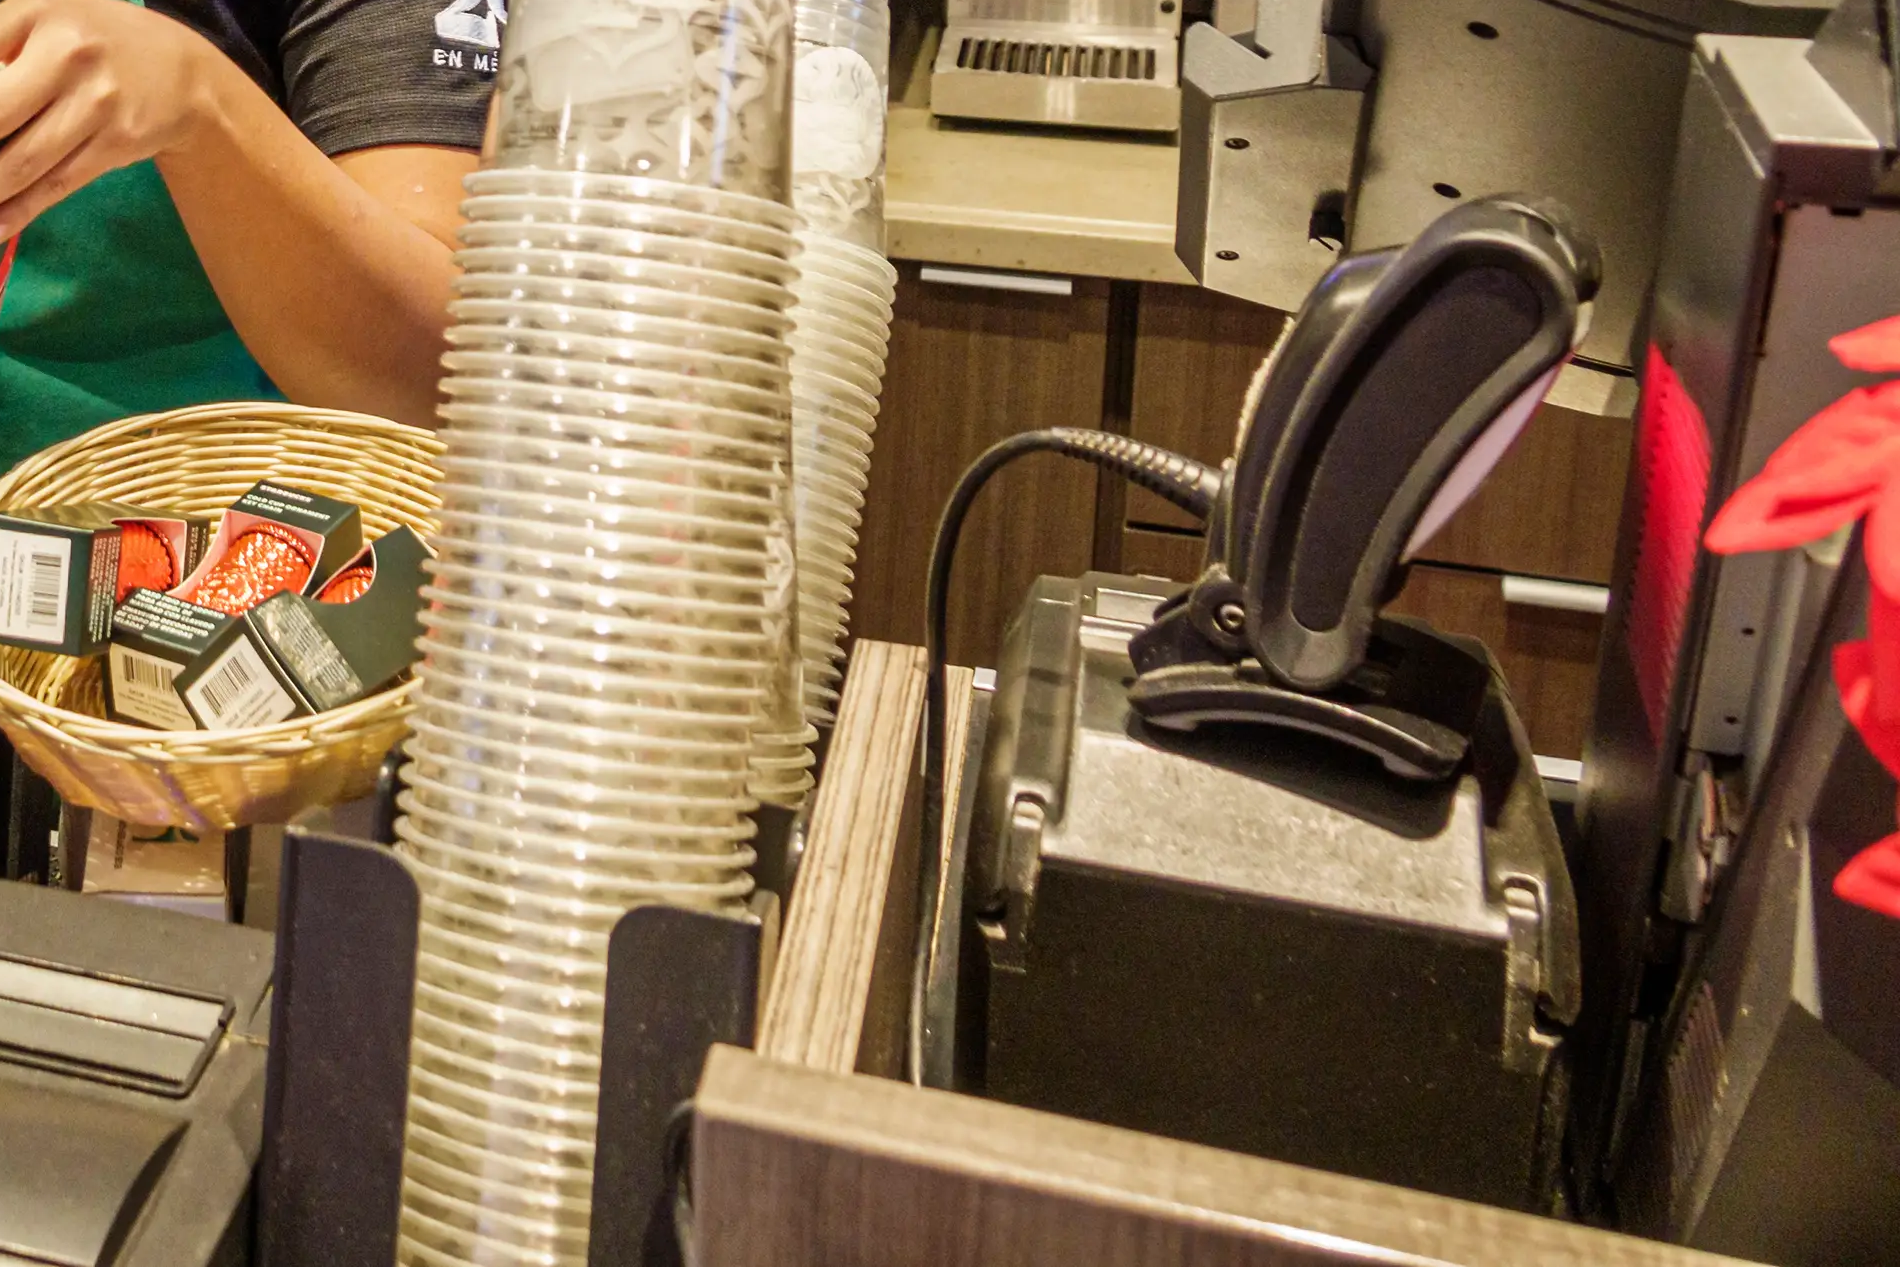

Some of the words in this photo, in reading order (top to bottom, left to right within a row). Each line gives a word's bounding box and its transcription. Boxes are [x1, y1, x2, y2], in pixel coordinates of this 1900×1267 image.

[433, 49, 463, 68] EN
[260, 484, 314, 503] STARBUCKS
[246, 494, 268, 504] COLD
[268, 499, 285, 508] CUP
[285, 504, 330, 521] ORNAMENT
